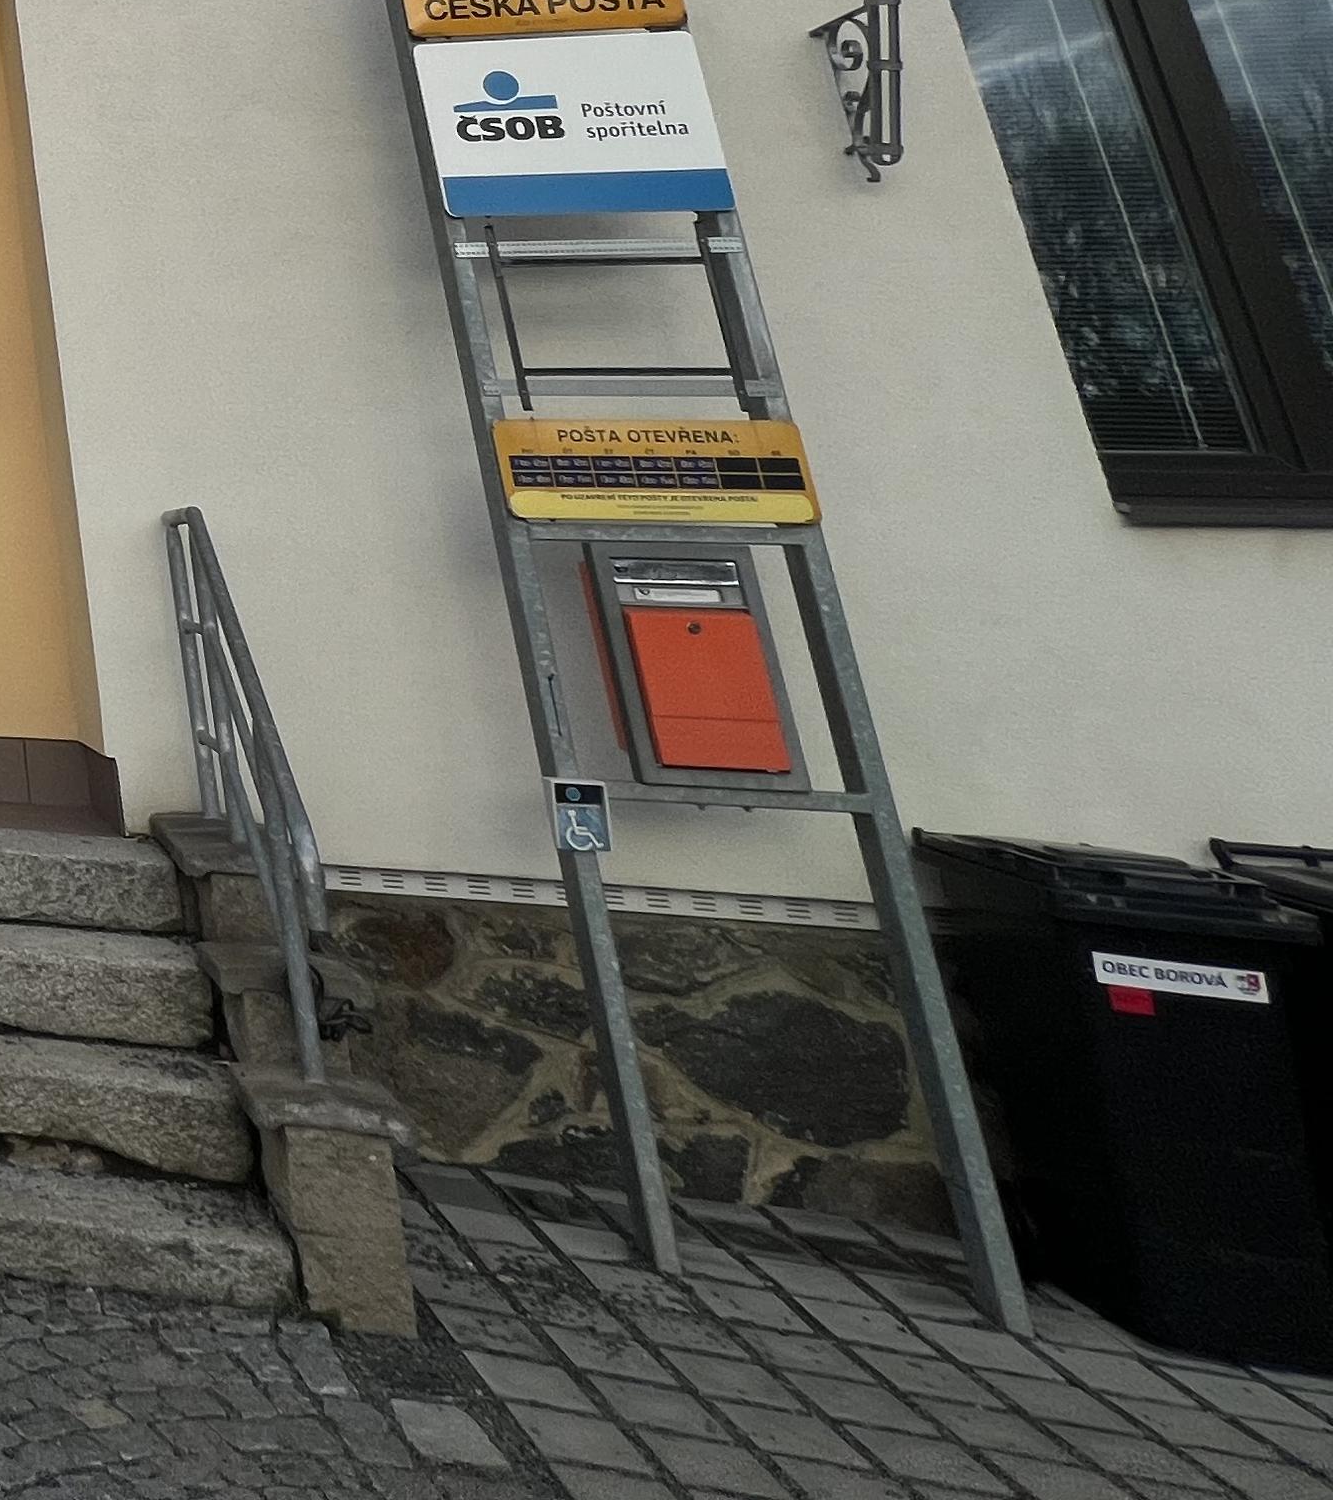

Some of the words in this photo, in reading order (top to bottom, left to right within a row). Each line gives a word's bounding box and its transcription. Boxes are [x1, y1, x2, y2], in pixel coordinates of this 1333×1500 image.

[581, 100, 667, 119] Poštovní
[456, 114, 565, 143] ČSOB
[586, 118, 689, 143] spořitelna
[557, 426, 622, 443] POŠTA
[627, 426, 740, 444] OTEVŘENA:
[1102, 960, 1149, 979] OBEC
[1155, 967, 1229, 988] BOROVÁ
